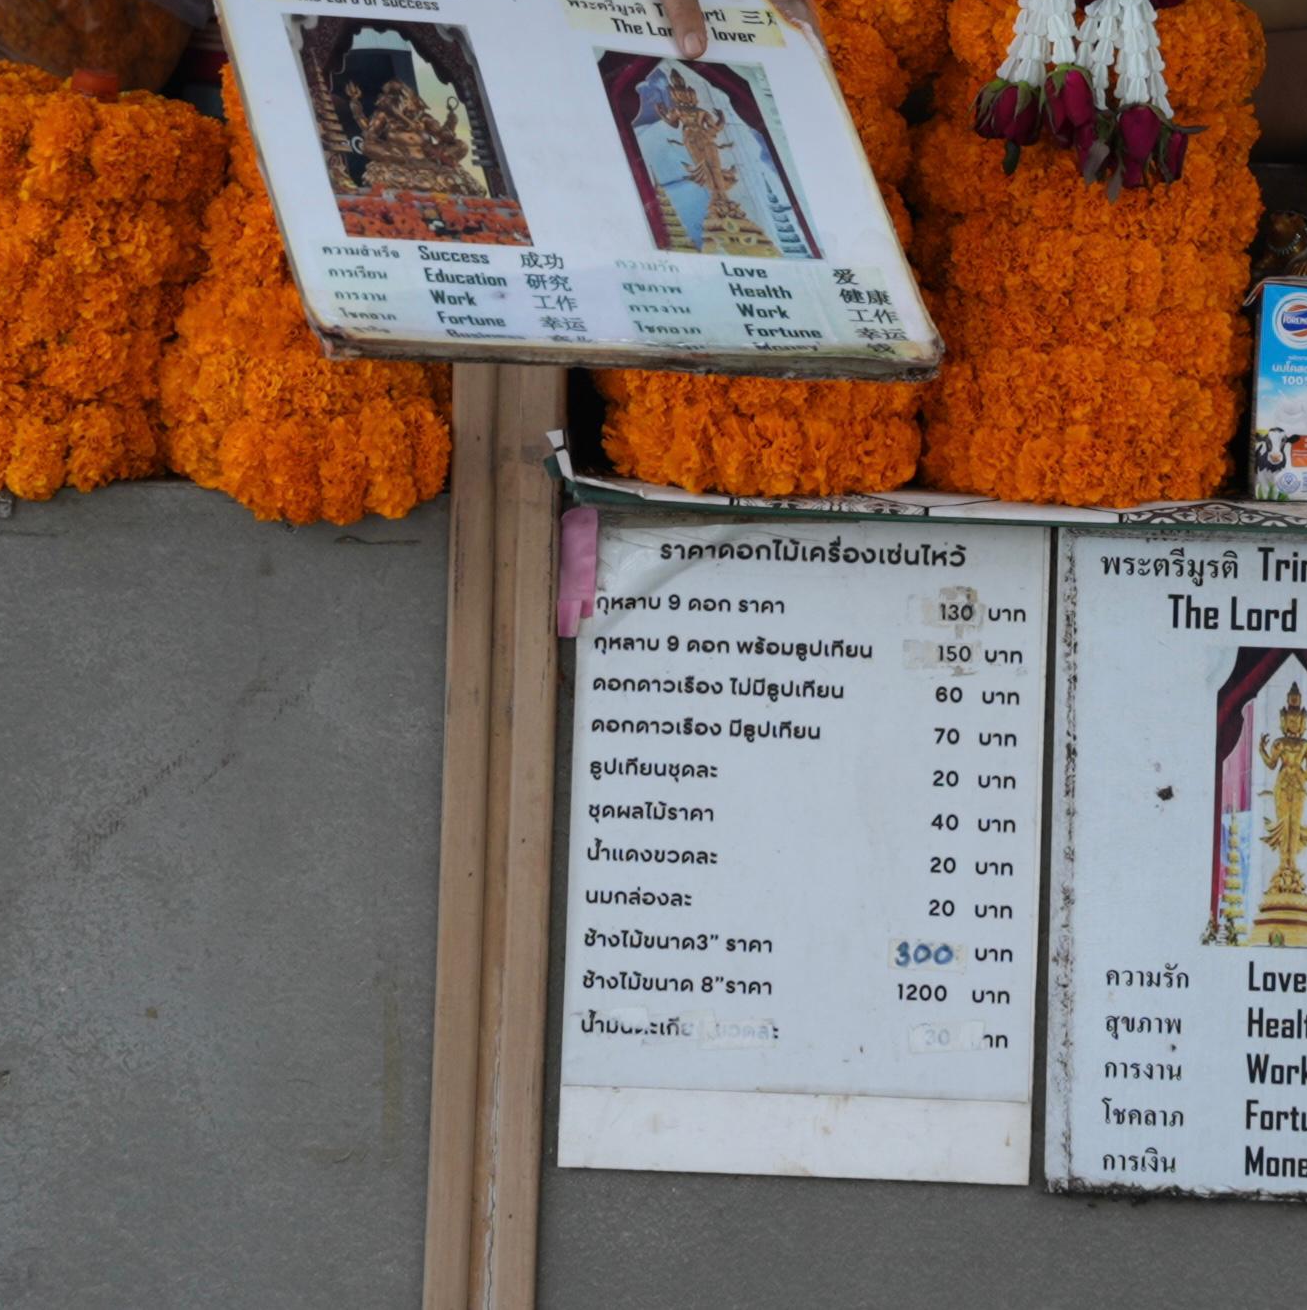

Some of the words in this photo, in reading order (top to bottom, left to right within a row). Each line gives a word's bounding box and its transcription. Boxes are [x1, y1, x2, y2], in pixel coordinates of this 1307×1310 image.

[610, 17, 644, 35] The
[417, 244, 490, 265] Success
[520, 251, 565, 270] 成功
[423, 266, 508, 288] Education
[720, 261, 769, 279] Love
[728, 282, 793, 300] Health
[1167, 593, 1220, 630] The
[1230, 595, 1298, 633] Lord
[930, 813, 959, 832] 40
[977, 818, 1016, 834] บาท
[929, 856, 957, 875] 20
[975, 861, 1014, 877] บาท
[928, 898, 956, 918] 20
[974, 904, 1013, 920] บาท
[1248, 960, 1307, 994] Love
